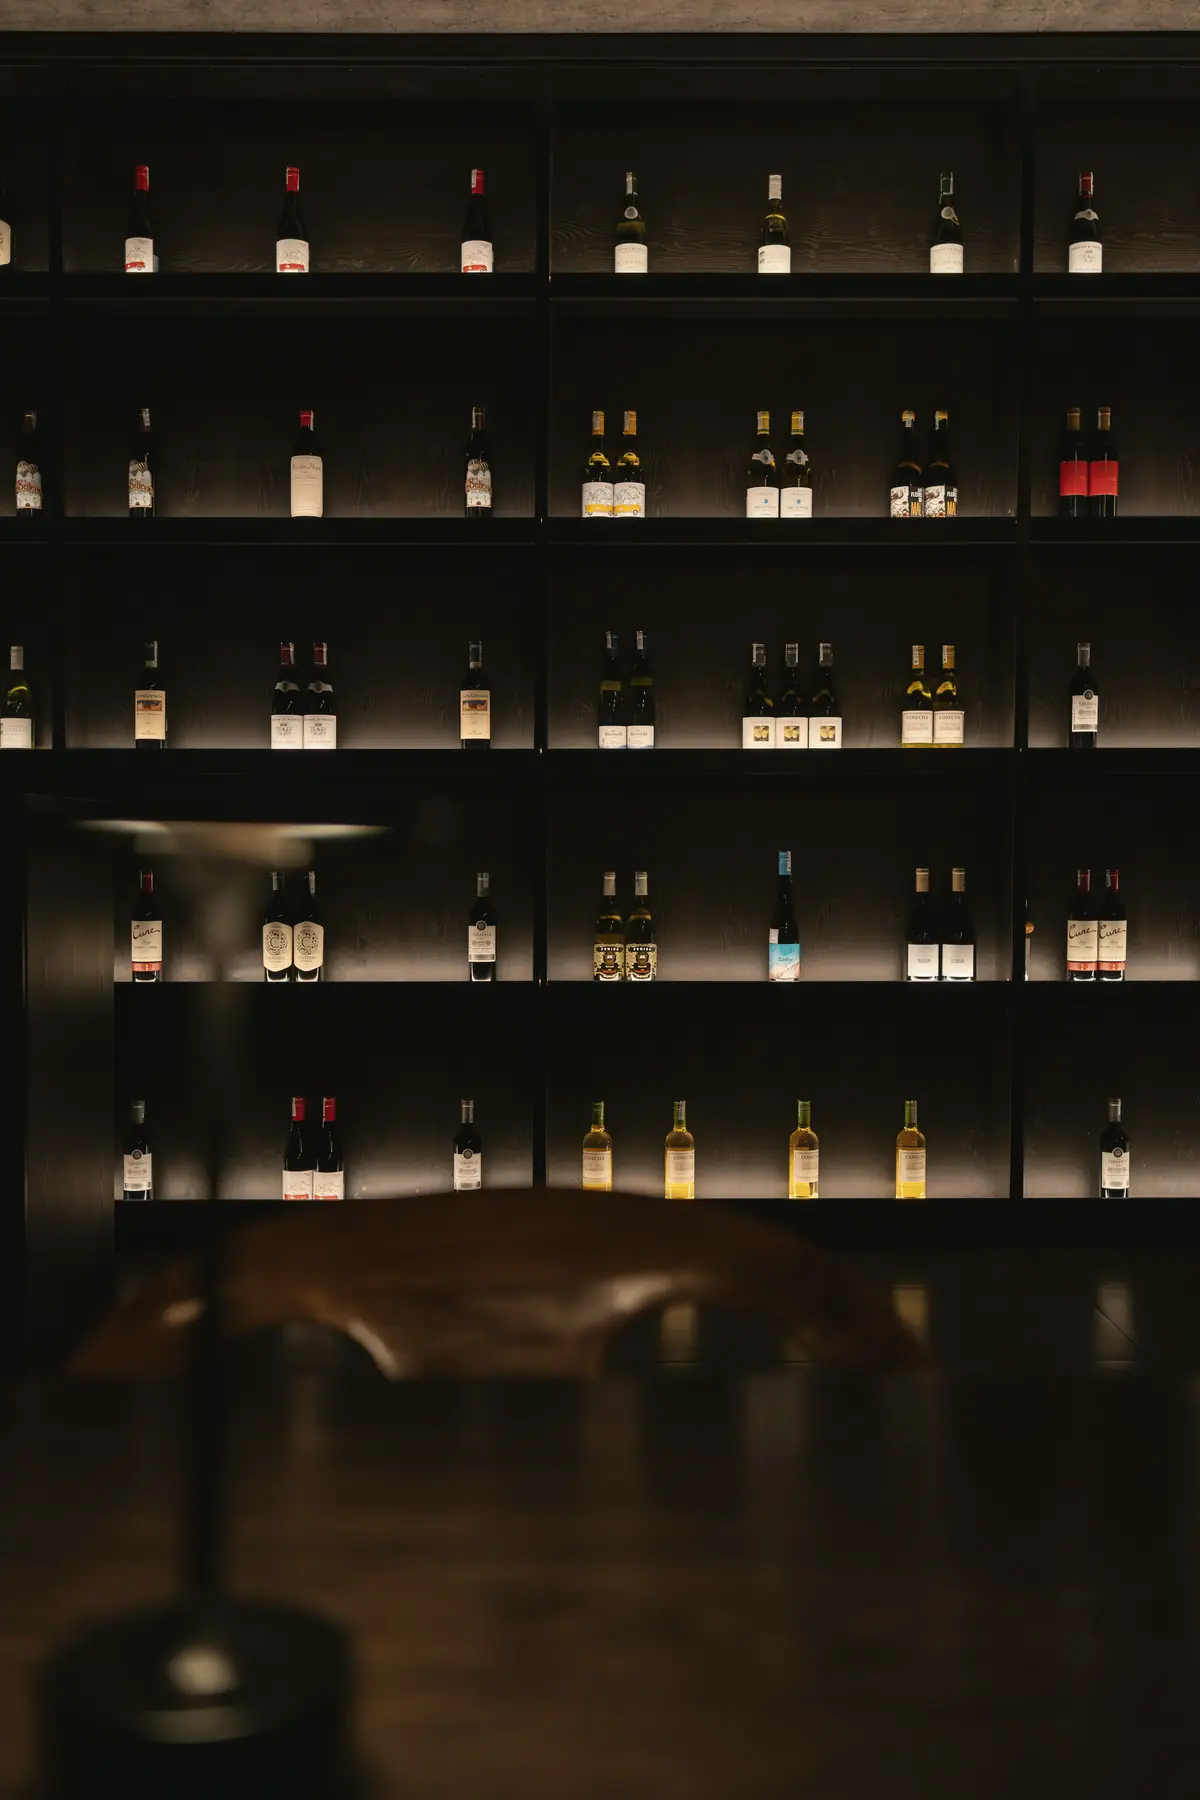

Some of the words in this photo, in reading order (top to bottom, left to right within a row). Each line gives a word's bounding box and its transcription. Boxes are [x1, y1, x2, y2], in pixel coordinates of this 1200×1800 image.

[133, 924, 161, 940] Cune
[1068, 923, 1097, 940] Cune
[1099, 923, 1127, 940] Cune
